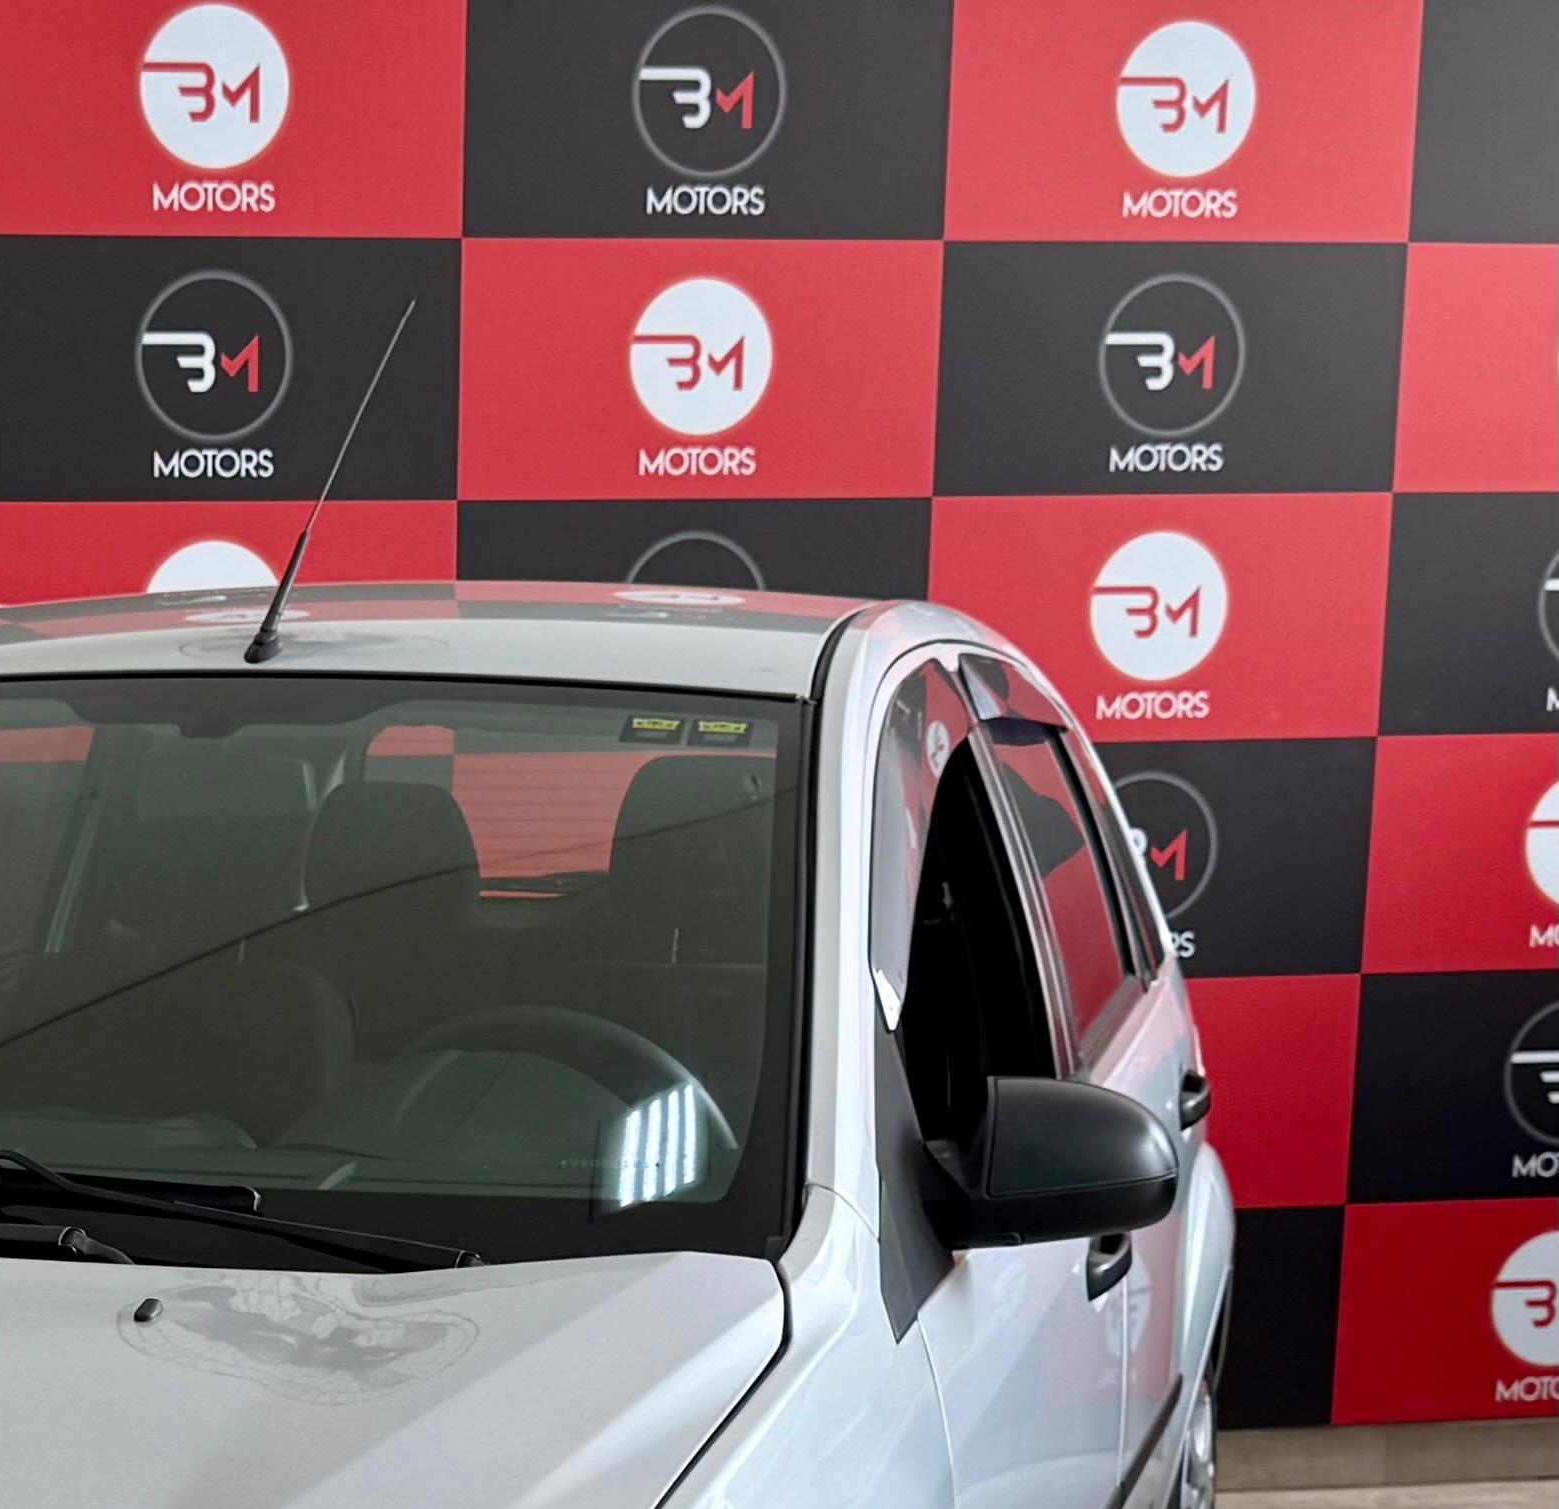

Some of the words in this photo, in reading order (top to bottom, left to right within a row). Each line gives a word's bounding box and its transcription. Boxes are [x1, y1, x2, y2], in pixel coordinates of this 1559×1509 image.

[143, 62, 260, 123] BM
[639, 66, 754, 131] BM
[1119, 77, 1231, 135] BM
[153, 182, 275, 212] MOTORS
[647, 185, 764, 216] MOTORS
[1123, 189, 1237, 219] MOTORS
[142, 331, 259, 393] BM
[633, 334, 748, 392] BM
[1105, 332, 1216, 390] BM
[153, 449, 274, 478] MOTORS
[639, 447, 756, 476] MOTORS
[1109, 443, 1223, 472] MOTORS
[1092, 584, 1201, 639] BM
[1096, 691, 1209, 720] MOTORS
[1130, 827, 1188, 881] M
[1495, 1280, 1558, 1329] B
